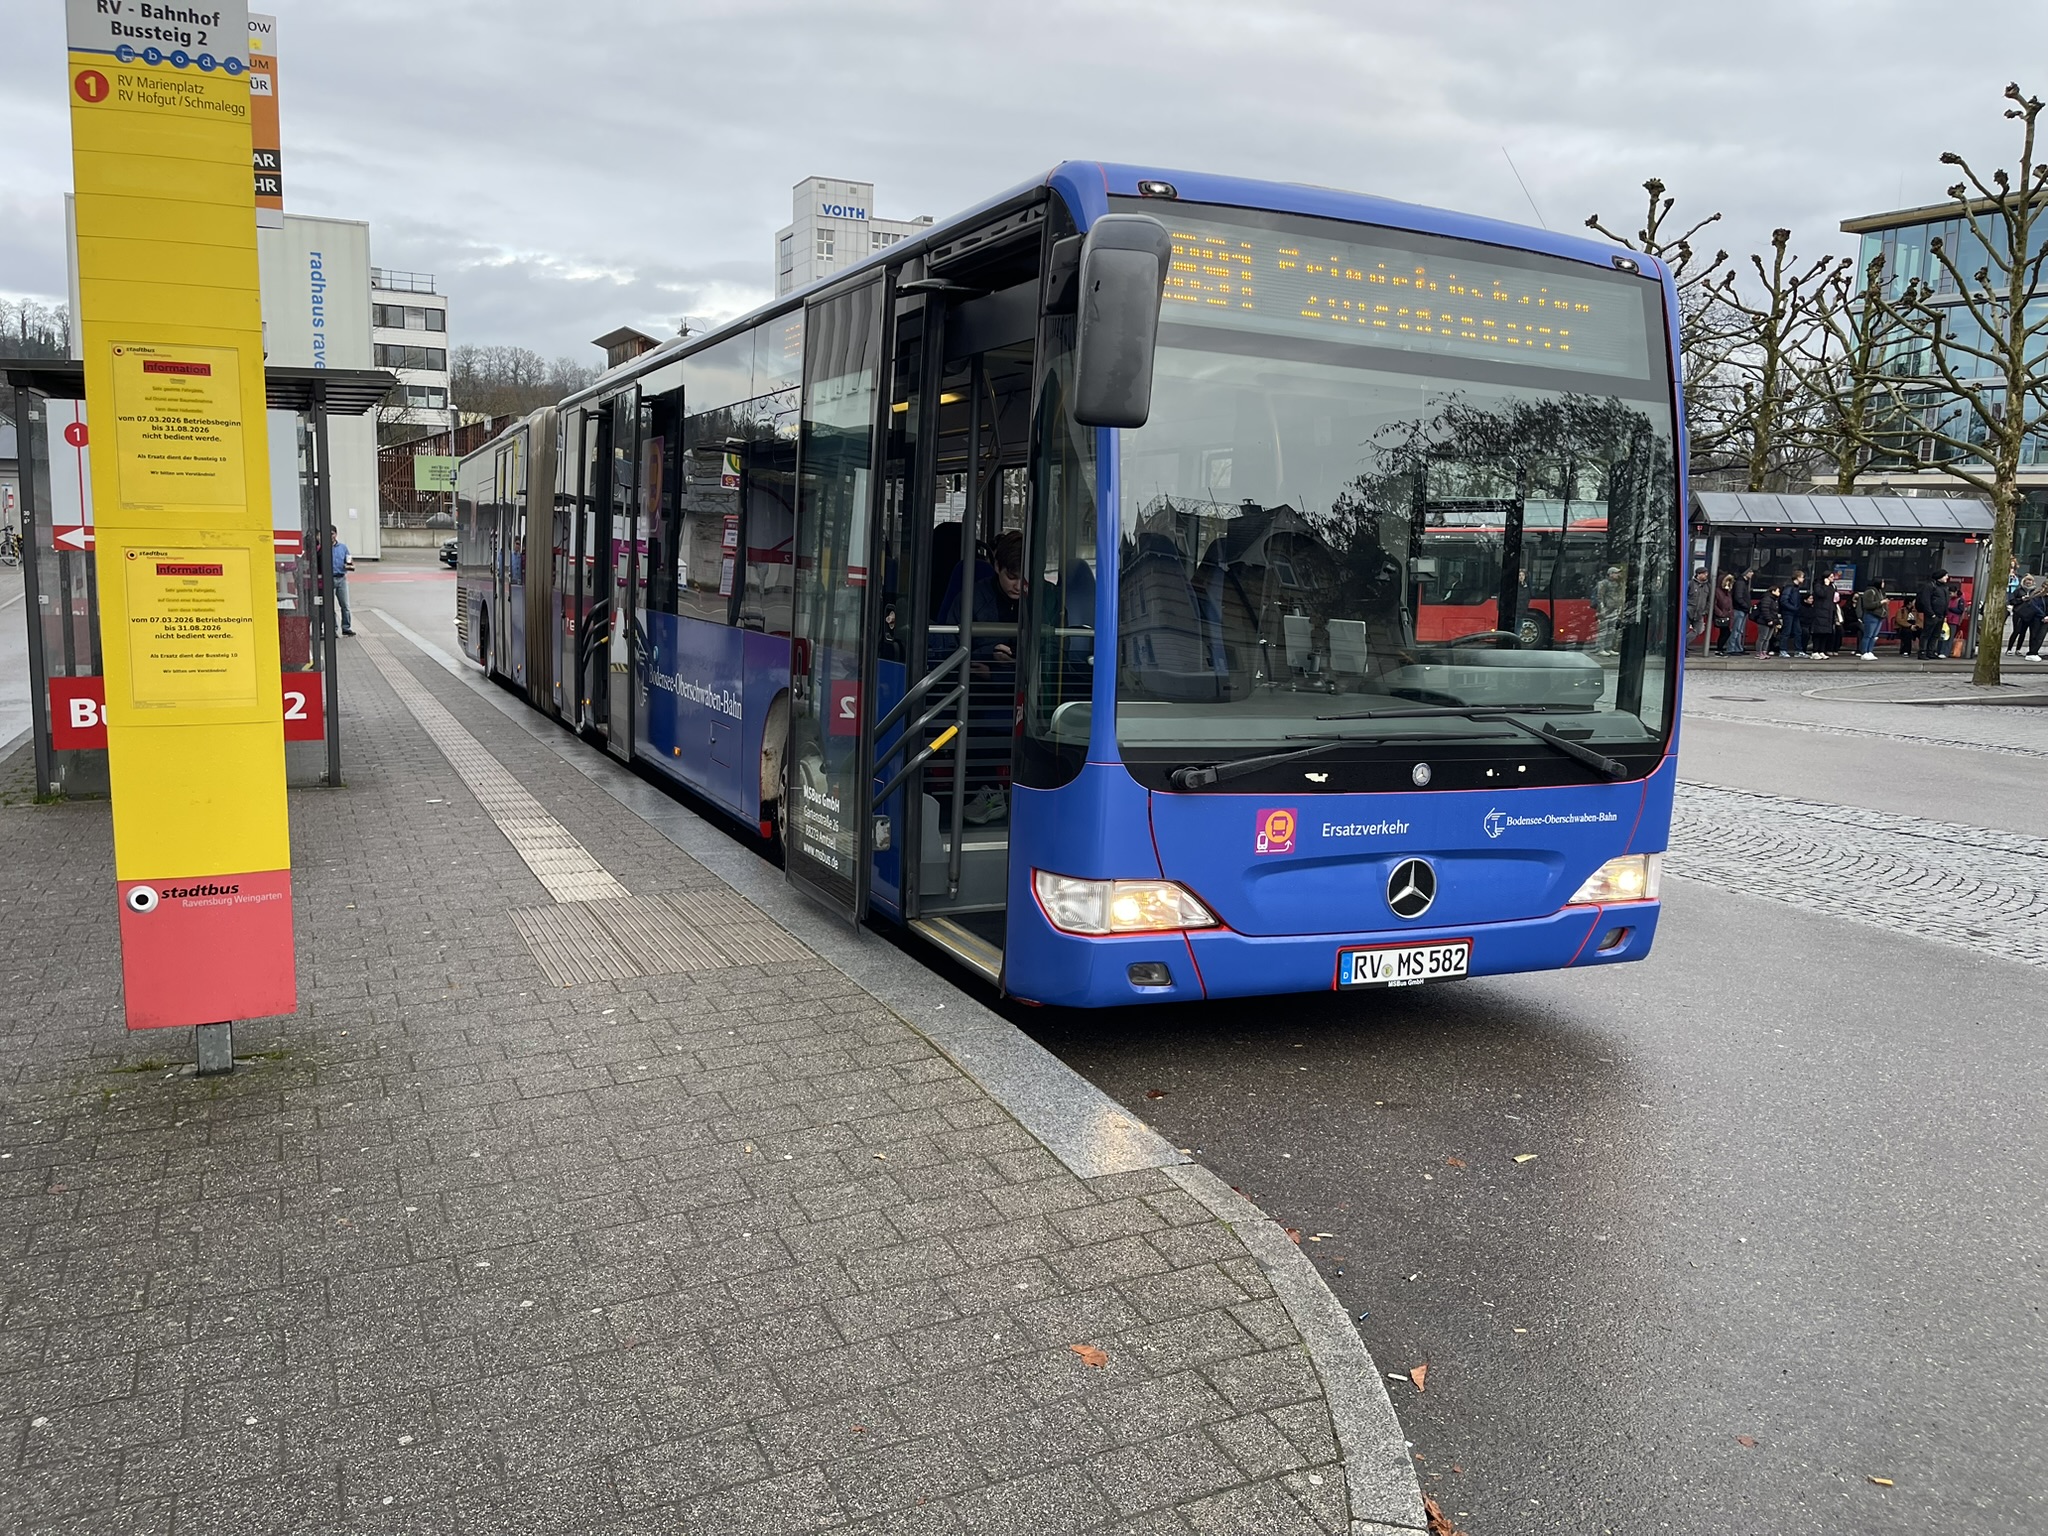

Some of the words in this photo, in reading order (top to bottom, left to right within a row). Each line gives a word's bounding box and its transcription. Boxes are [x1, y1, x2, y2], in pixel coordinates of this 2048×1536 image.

[97, 0, 122, 15] RV
[141, 3, 220, 27] Bahnhof
[111, 21, 191, 46] Bussteig
[197, 32, 208, 46] 2
[84, 76, 97, 97] 1
[118, 75, 134, 86] RV
[137, 77, 204, 94] Marienplatz
[118, 90, 134, 101] RV
[138, 92, 176, 108] Hofgut
[184, 96, 246, 116] Schmalegg
[822, 203, 865, 220] VOITH
[310, 252, 326, 328] radhaus
[136, 416, 182, 424] 07.03.2026
[184, 418, 241, 427] Betriebsbeginn
[165, 425, 210, 433] 31.08.2026
[74, 428, 80, 441] 1
[1823, 536, 1853, 548] Regio
[648, 663, 742, 720] Bodensee-Oberschwaben-Bahn
[284, 692, 307, 720] 2
[804, 784, 822, 804] MSBus
[822, 793, 840, 813] GmbH
[1322, 819, 1410, 837] Ersatzverkehr
[1506, 812, 1618, 826] Bodensee-Oberschwaben-Bahn
[161, 883, 239, 899] stadtbus
[182, 896, 232, 908] Ravensburg
[234, 892, 283, 904] Weingarten
[1354, 954, 1383, 980] RV
[1398, 952, 1424, 976] MS
[1429, 948, 1466, 973] 582
[1408, 978, 1424, 986] GmbH
